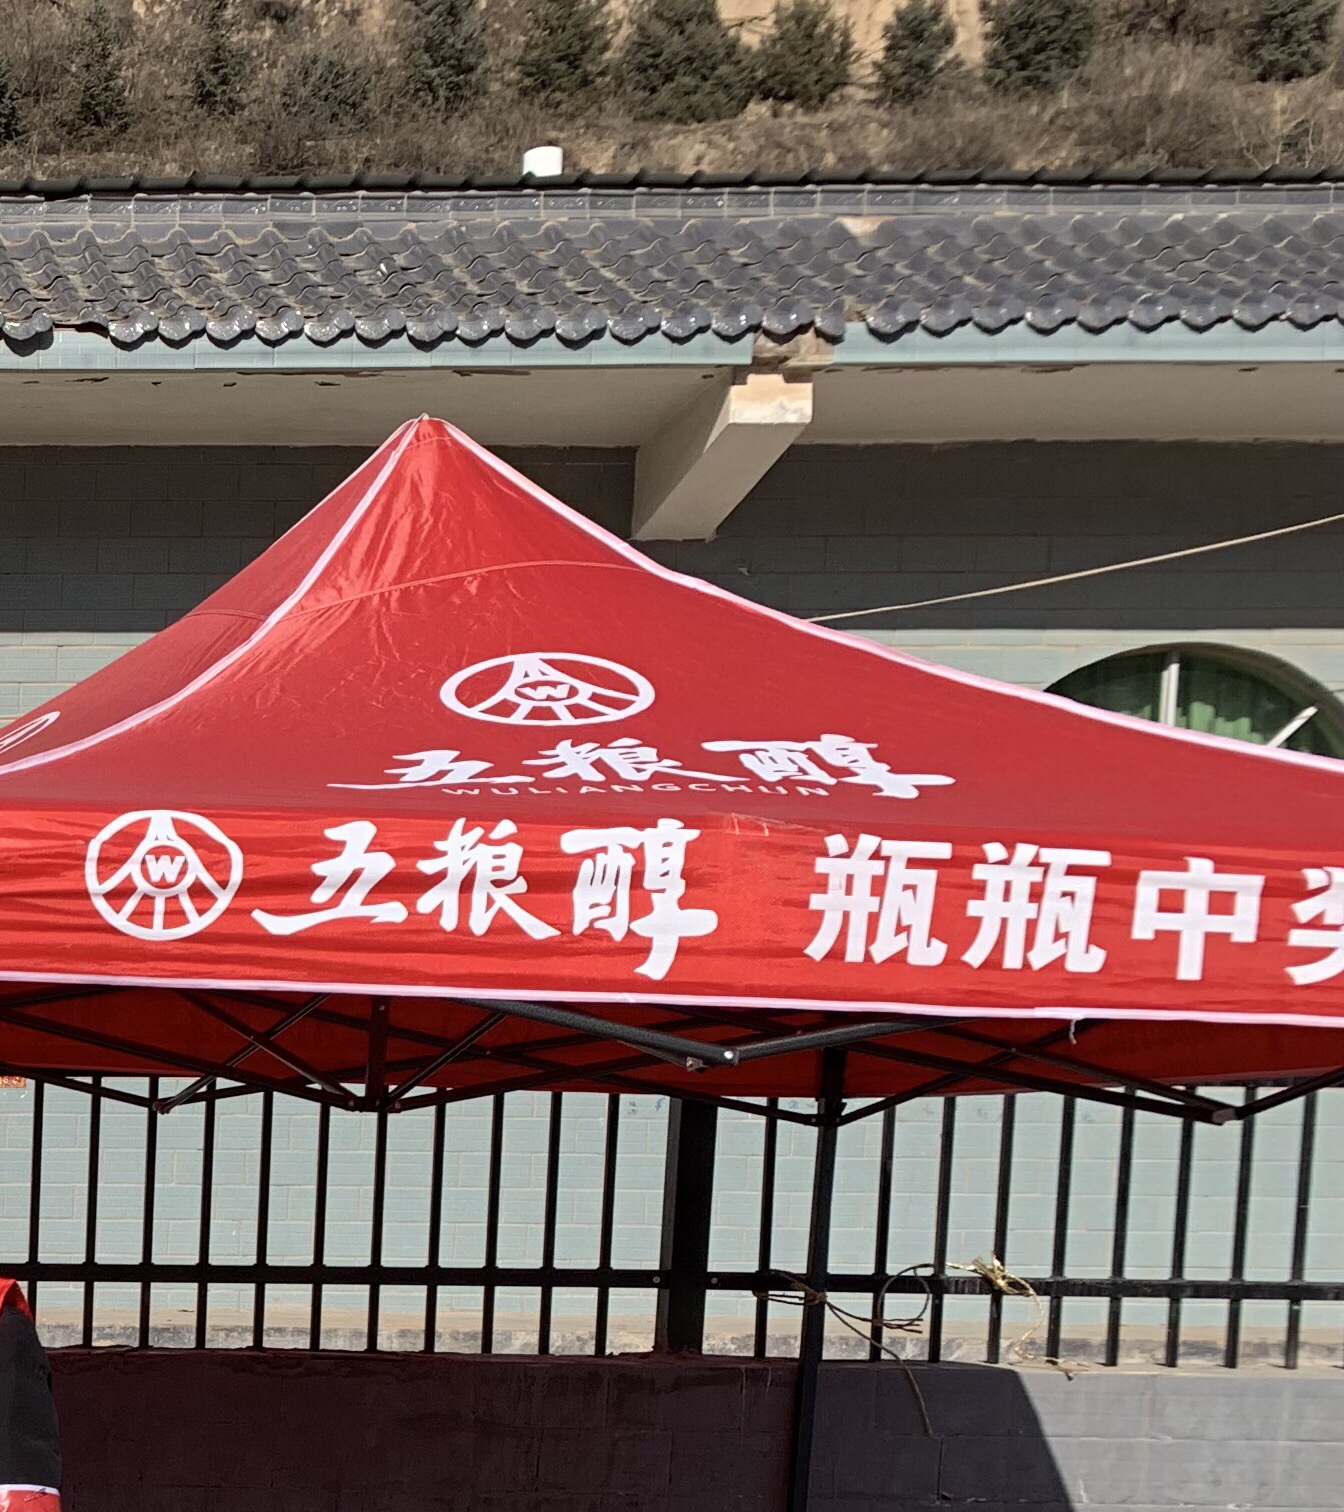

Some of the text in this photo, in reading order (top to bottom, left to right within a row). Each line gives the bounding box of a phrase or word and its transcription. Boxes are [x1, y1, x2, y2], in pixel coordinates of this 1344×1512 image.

[326, 732, 956, 800] 五粮醇
[442, 783, 830, 797] WULIANGCHUN
[250, 817, 718, 981] 五粮醇
